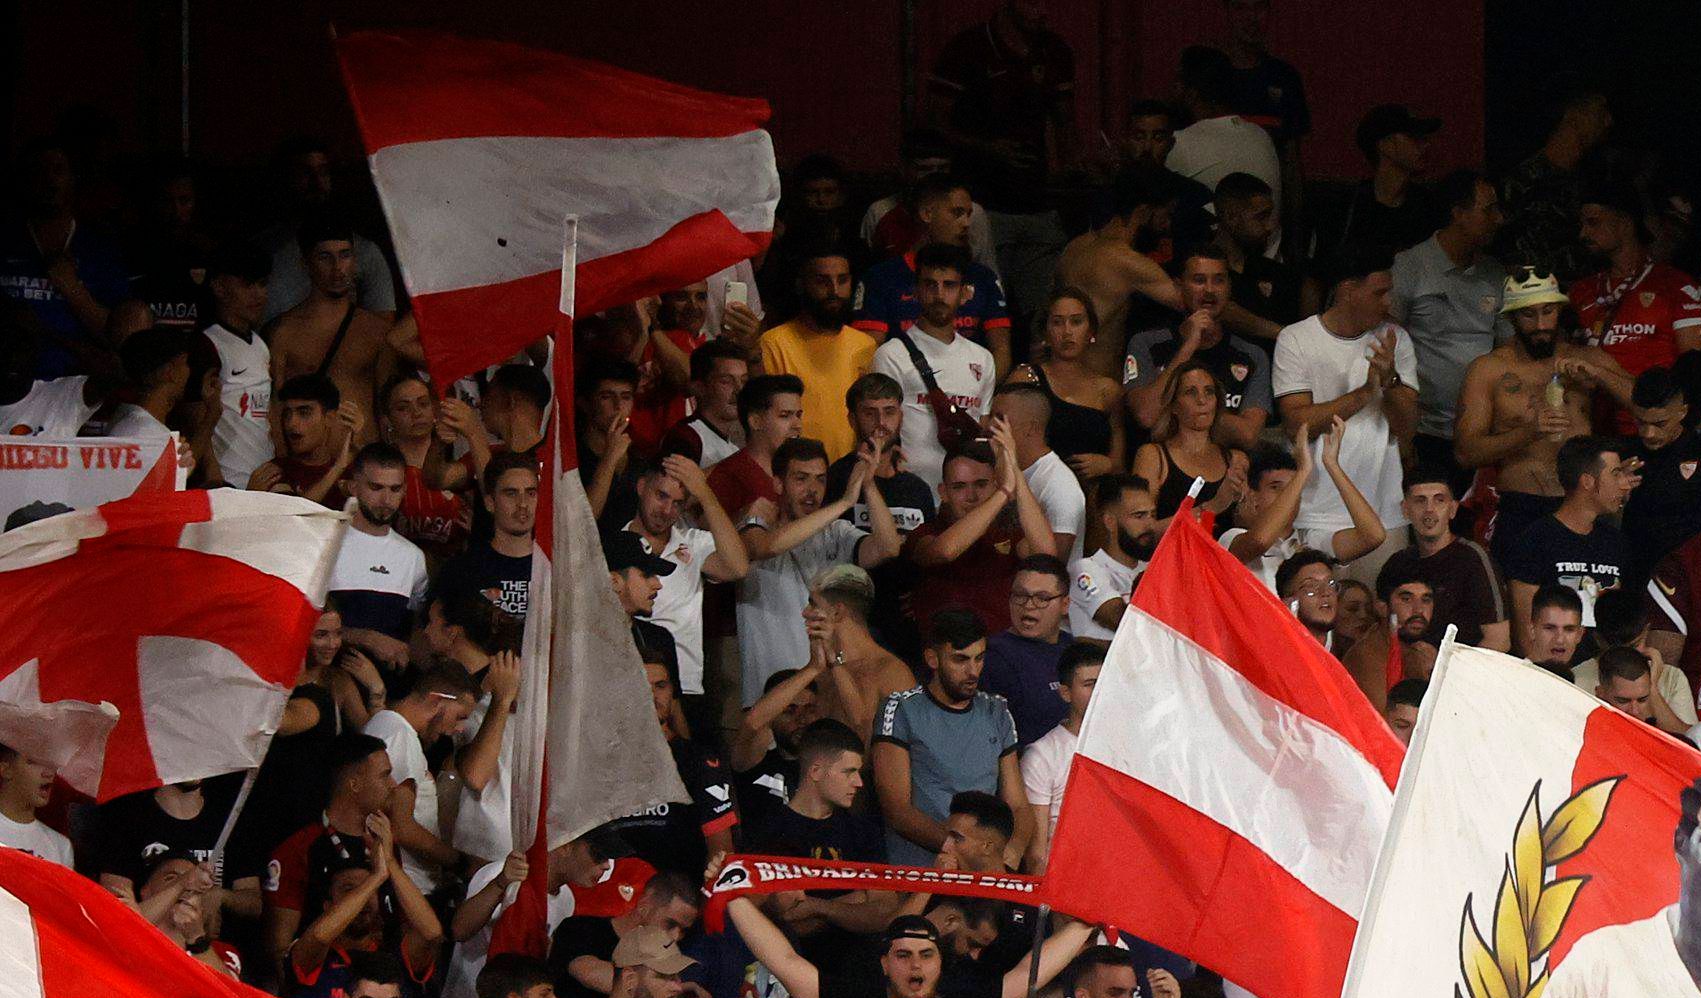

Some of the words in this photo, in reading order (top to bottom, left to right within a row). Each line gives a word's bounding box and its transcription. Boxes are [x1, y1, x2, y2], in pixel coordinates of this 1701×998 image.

[80, 444, 142, 469] VIVE
[1555, 562, 1589, 573] TRUE
[1590, 563, 1620, 576] LOVE
[501, 580, 527, 591] THE
